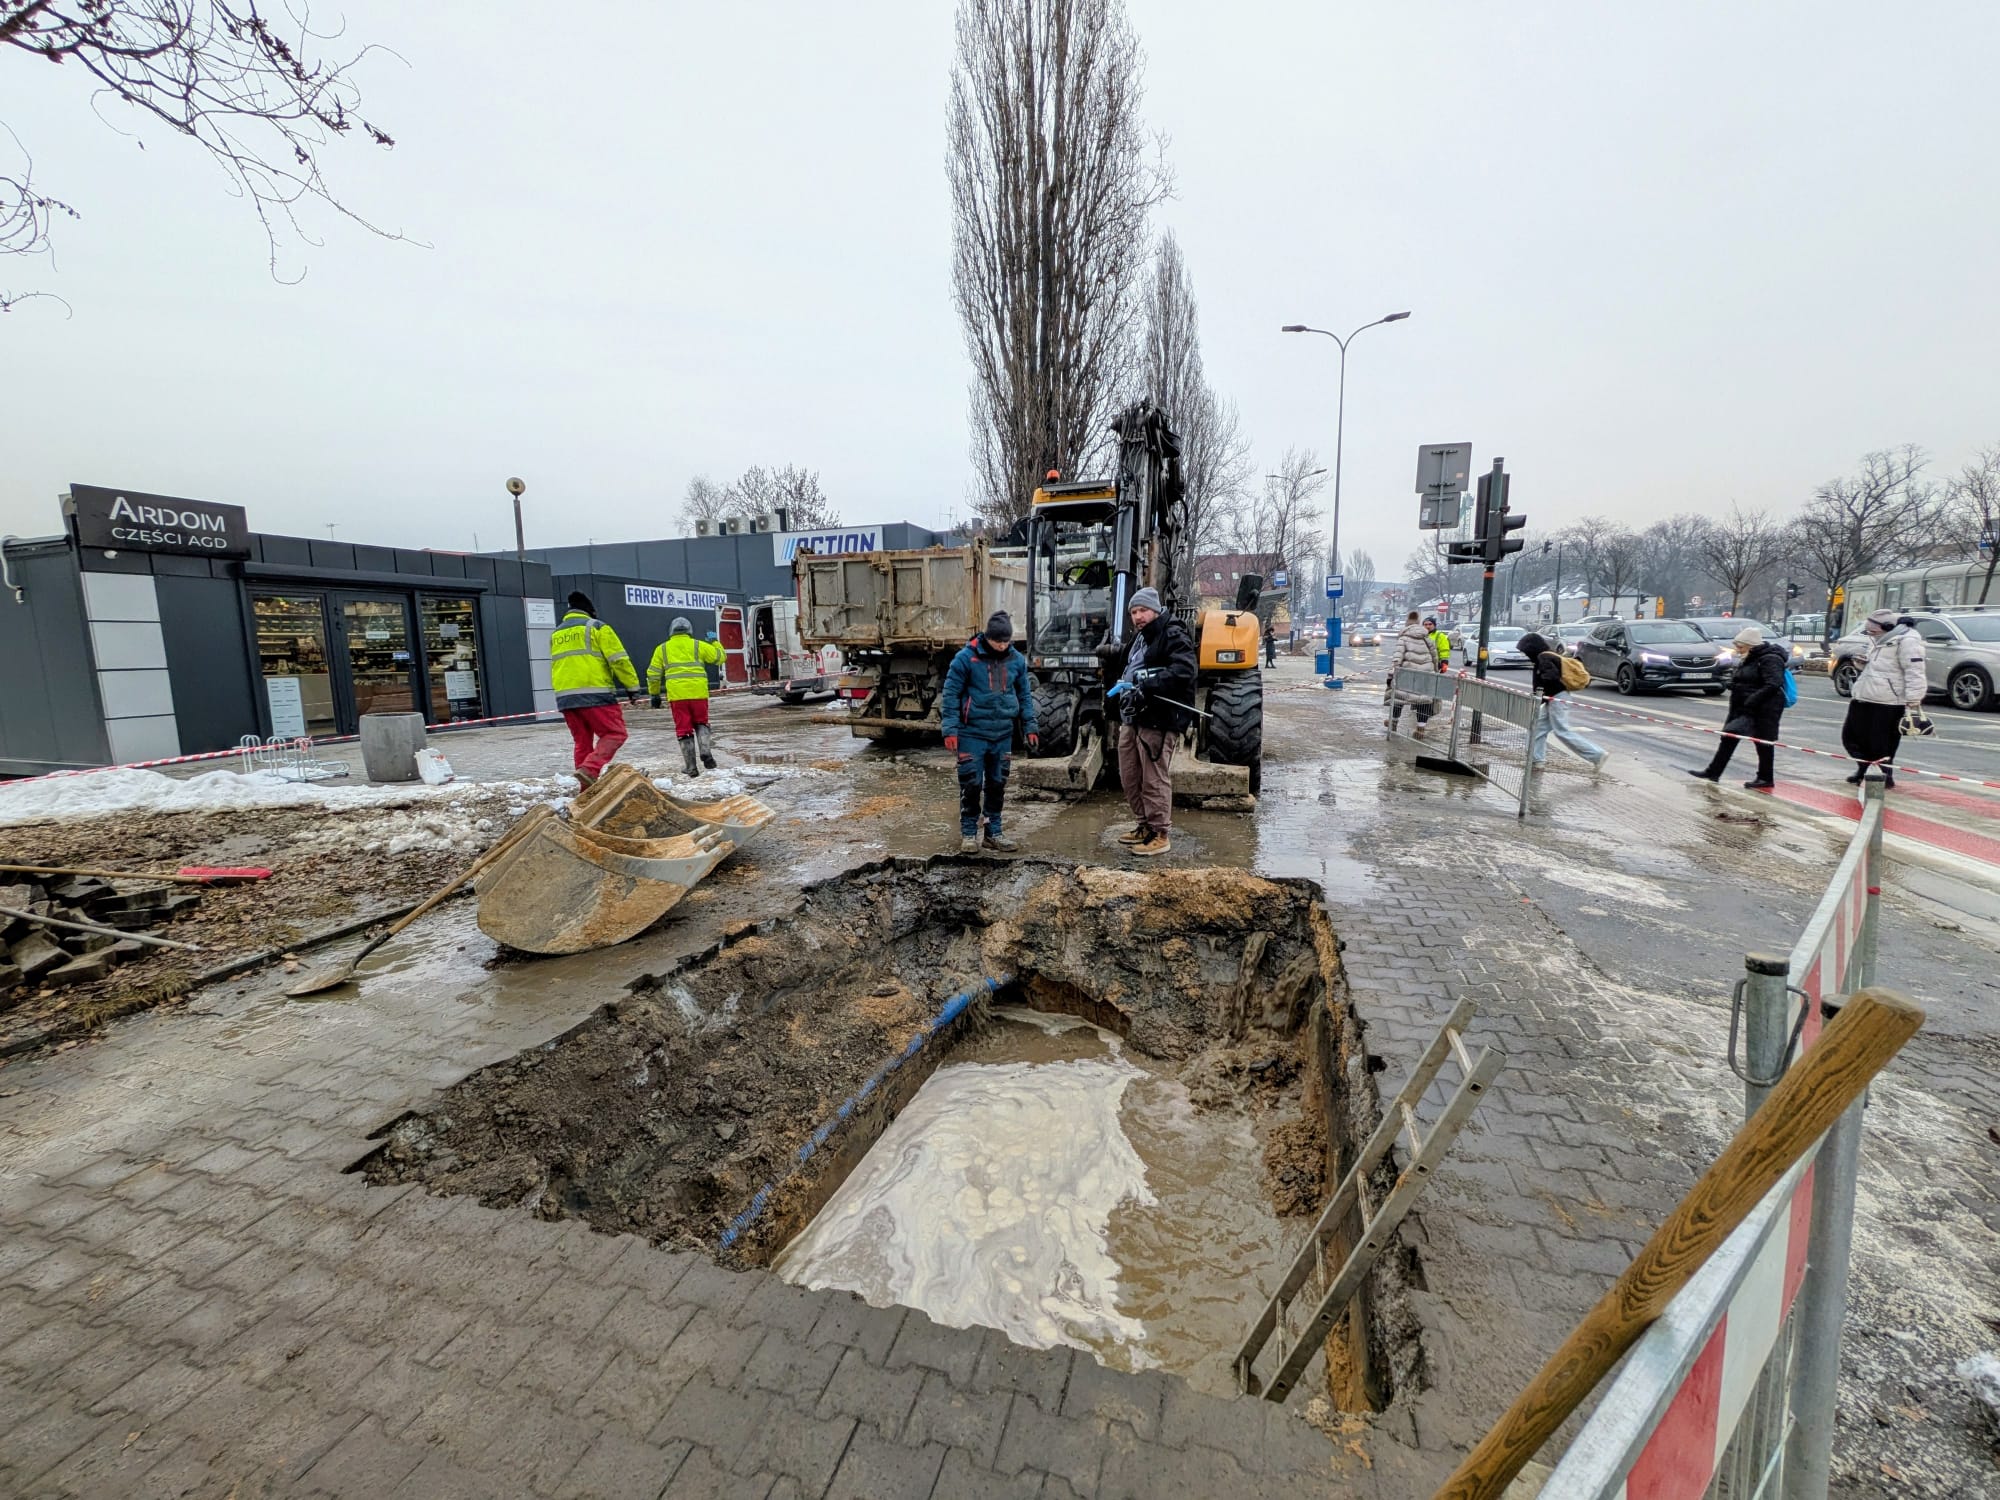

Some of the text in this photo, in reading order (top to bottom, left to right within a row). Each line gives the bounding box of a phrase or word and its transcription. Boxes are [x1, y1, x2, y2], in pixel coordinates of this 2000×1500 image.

[109, 496, 225, 532] ARDOM
[111, 527, 227, 549] CZĘŚCI AGD
[627, 587, 665, 605] FARBY
[553, 632, 580, 646] robin
